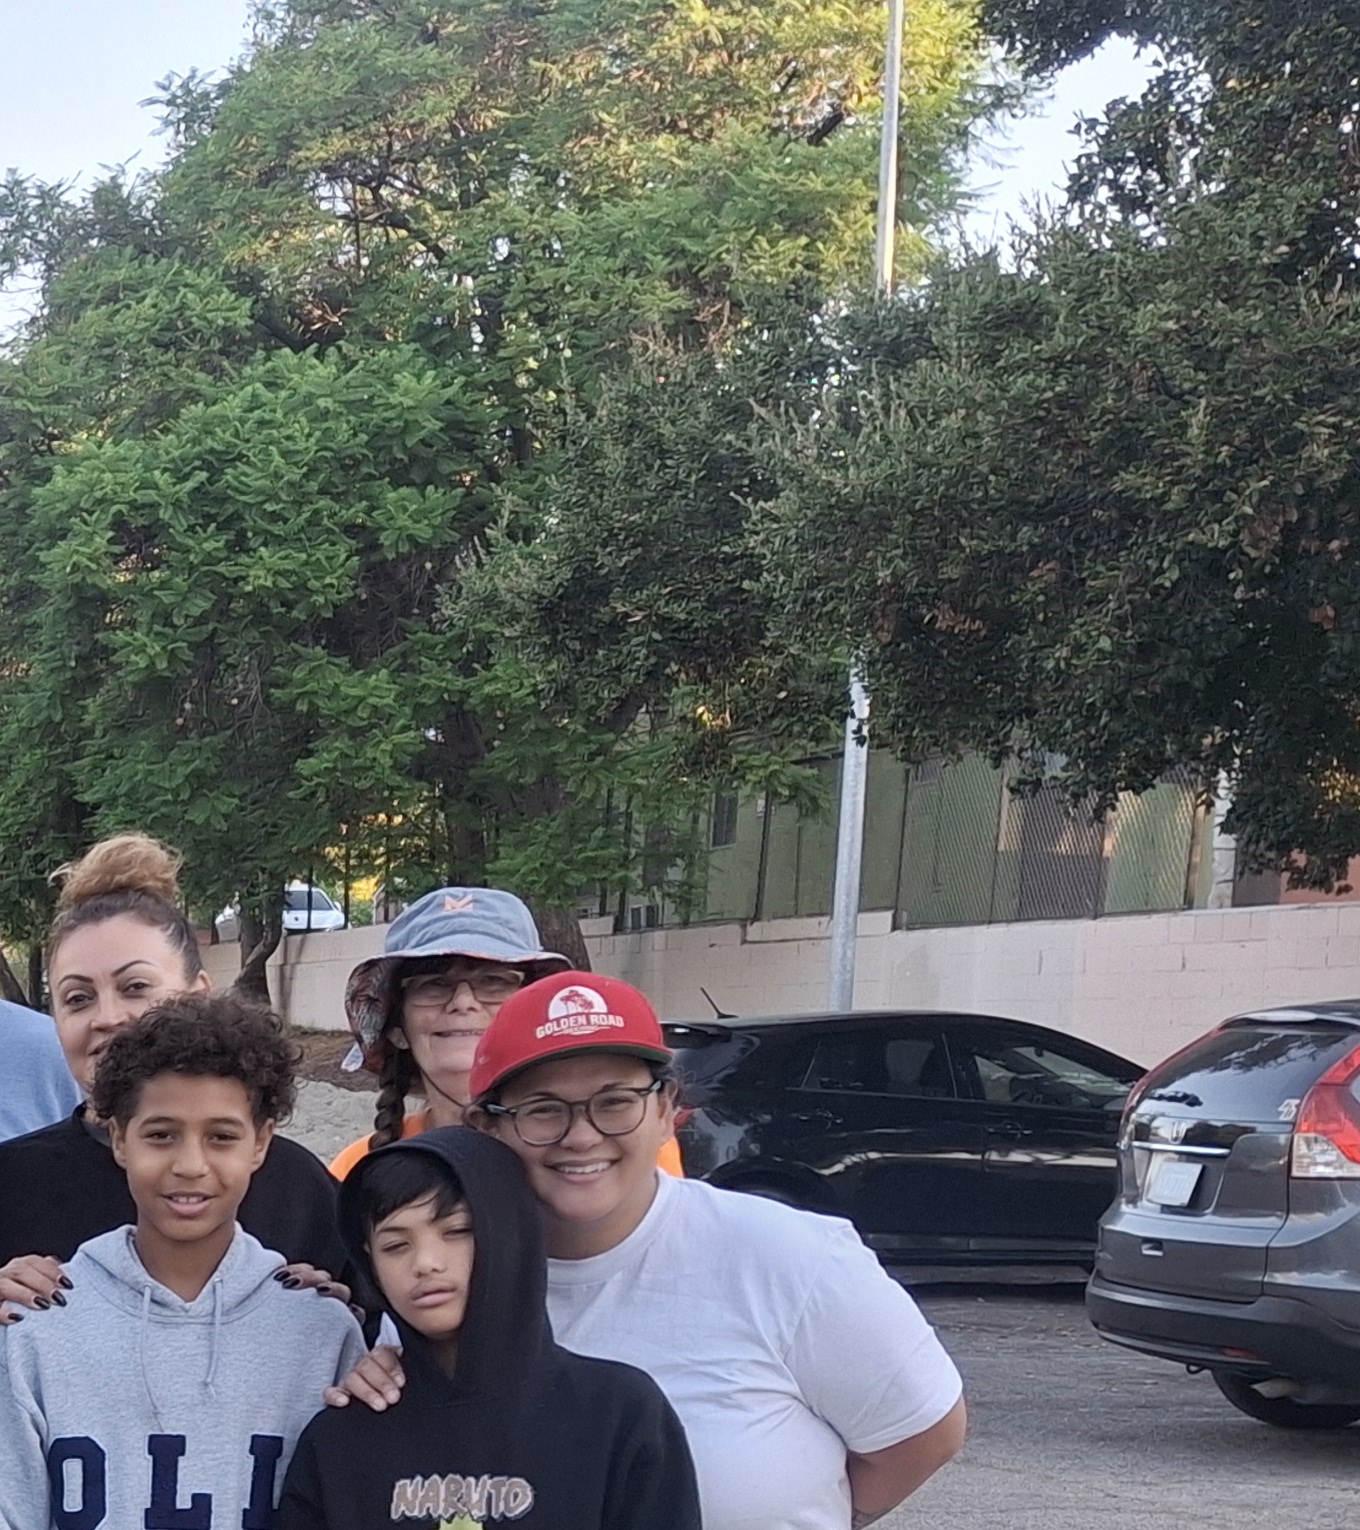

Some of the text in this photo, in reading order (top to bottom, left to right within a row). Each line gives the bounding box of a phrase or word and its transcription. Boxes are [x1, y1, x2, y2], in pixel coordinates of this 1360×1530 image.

[535, 1014, 588, 1040] GOLDEN
[589, 1013, 625, 1029] ROAD
[390, 1473, 536, 1521] NARUTO
